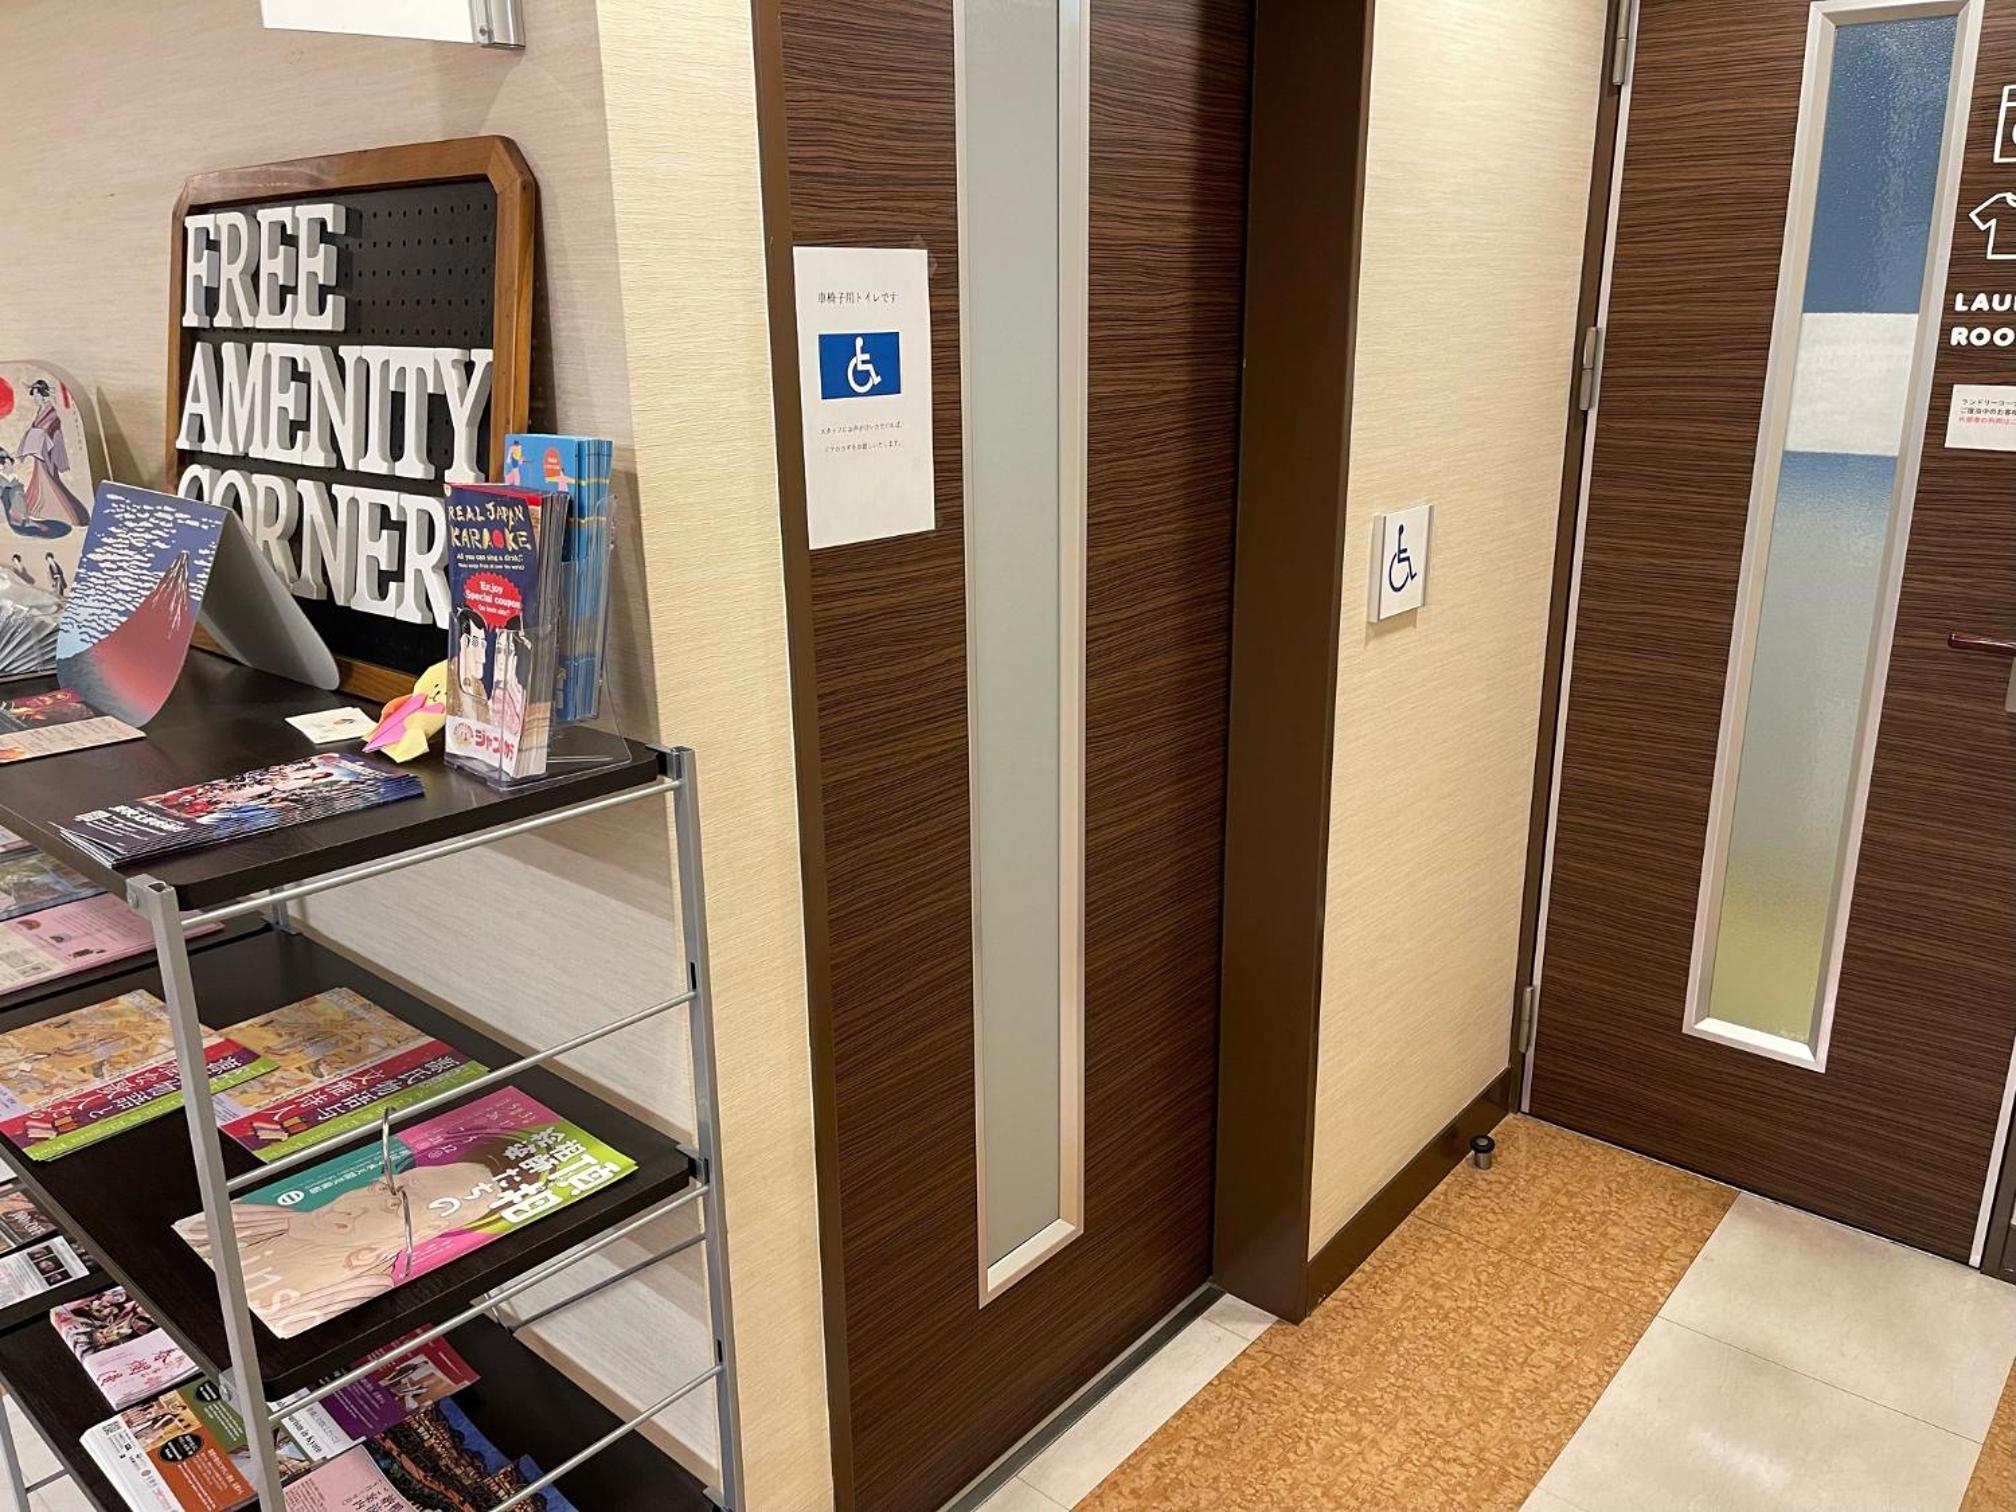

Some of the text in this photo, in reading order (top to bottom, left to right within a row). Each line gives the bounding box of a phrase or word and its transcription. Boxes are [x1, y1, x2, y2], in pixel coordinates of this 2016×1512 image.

[182, 203, 346, 331] FREE
[816, 290, 899, 305] 車椅子用トイレです
[1954, 292, 2016, 312] LAU
[175, 342, 493, 482] AMENITY
[448, 501, 526, 531] REAL JAPAN
[451, 526, 532, 551] KARAOKE
[465, 590, 494, 605] Special
[494, 595, 522, 610] coupon
[479, 581, 504, 595] Enjoy
[89, 1055, 242, 1119] 源物語と
[503, 1126, 566, 1160] 絵姿
[428, 1139, 586, 1217] 祖師たちの
[489, 1153, 621, 1223] 頂相
